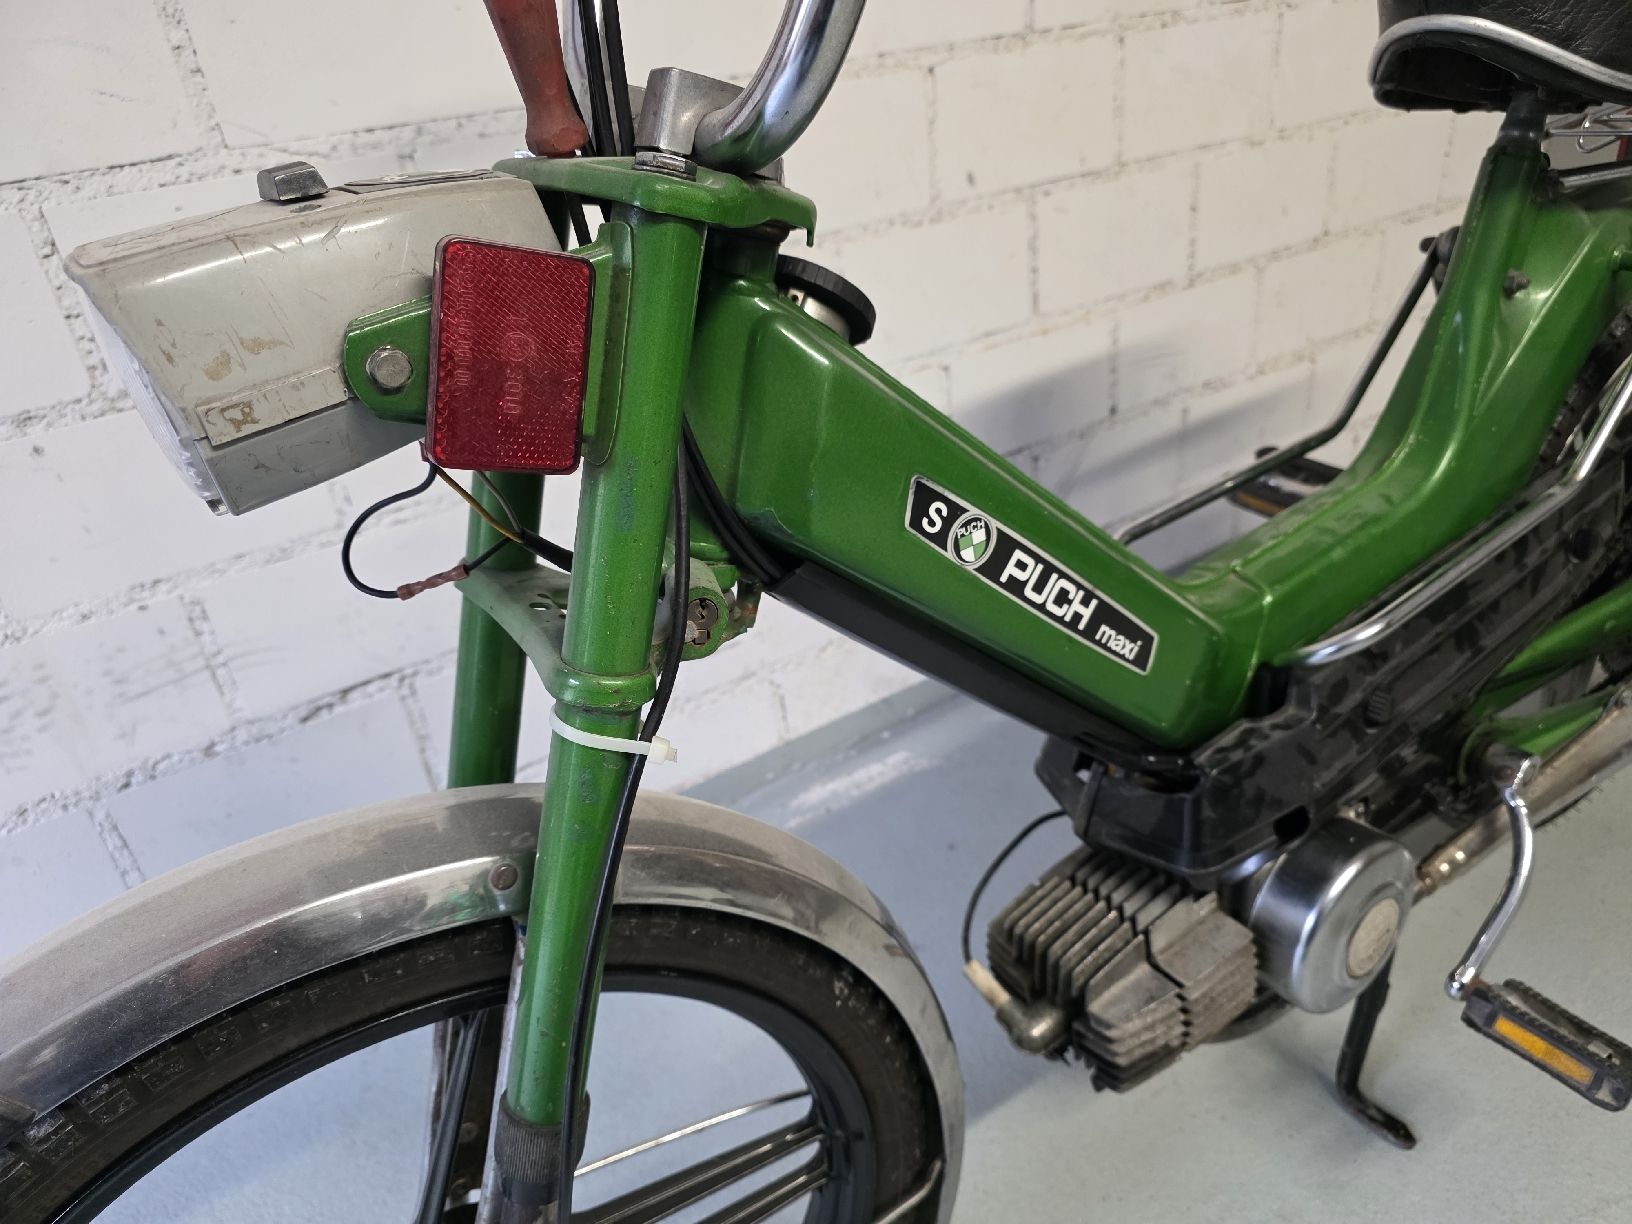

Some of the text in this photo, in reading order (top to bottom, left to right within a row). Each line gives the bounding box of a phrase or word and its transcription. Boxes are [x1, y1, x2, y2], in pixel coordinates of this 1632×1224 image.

[921, 501, 948, 534] S
[957, 519, 986, 539] PUCH
[1000, 549, 1142, 661] PUCH maxi
